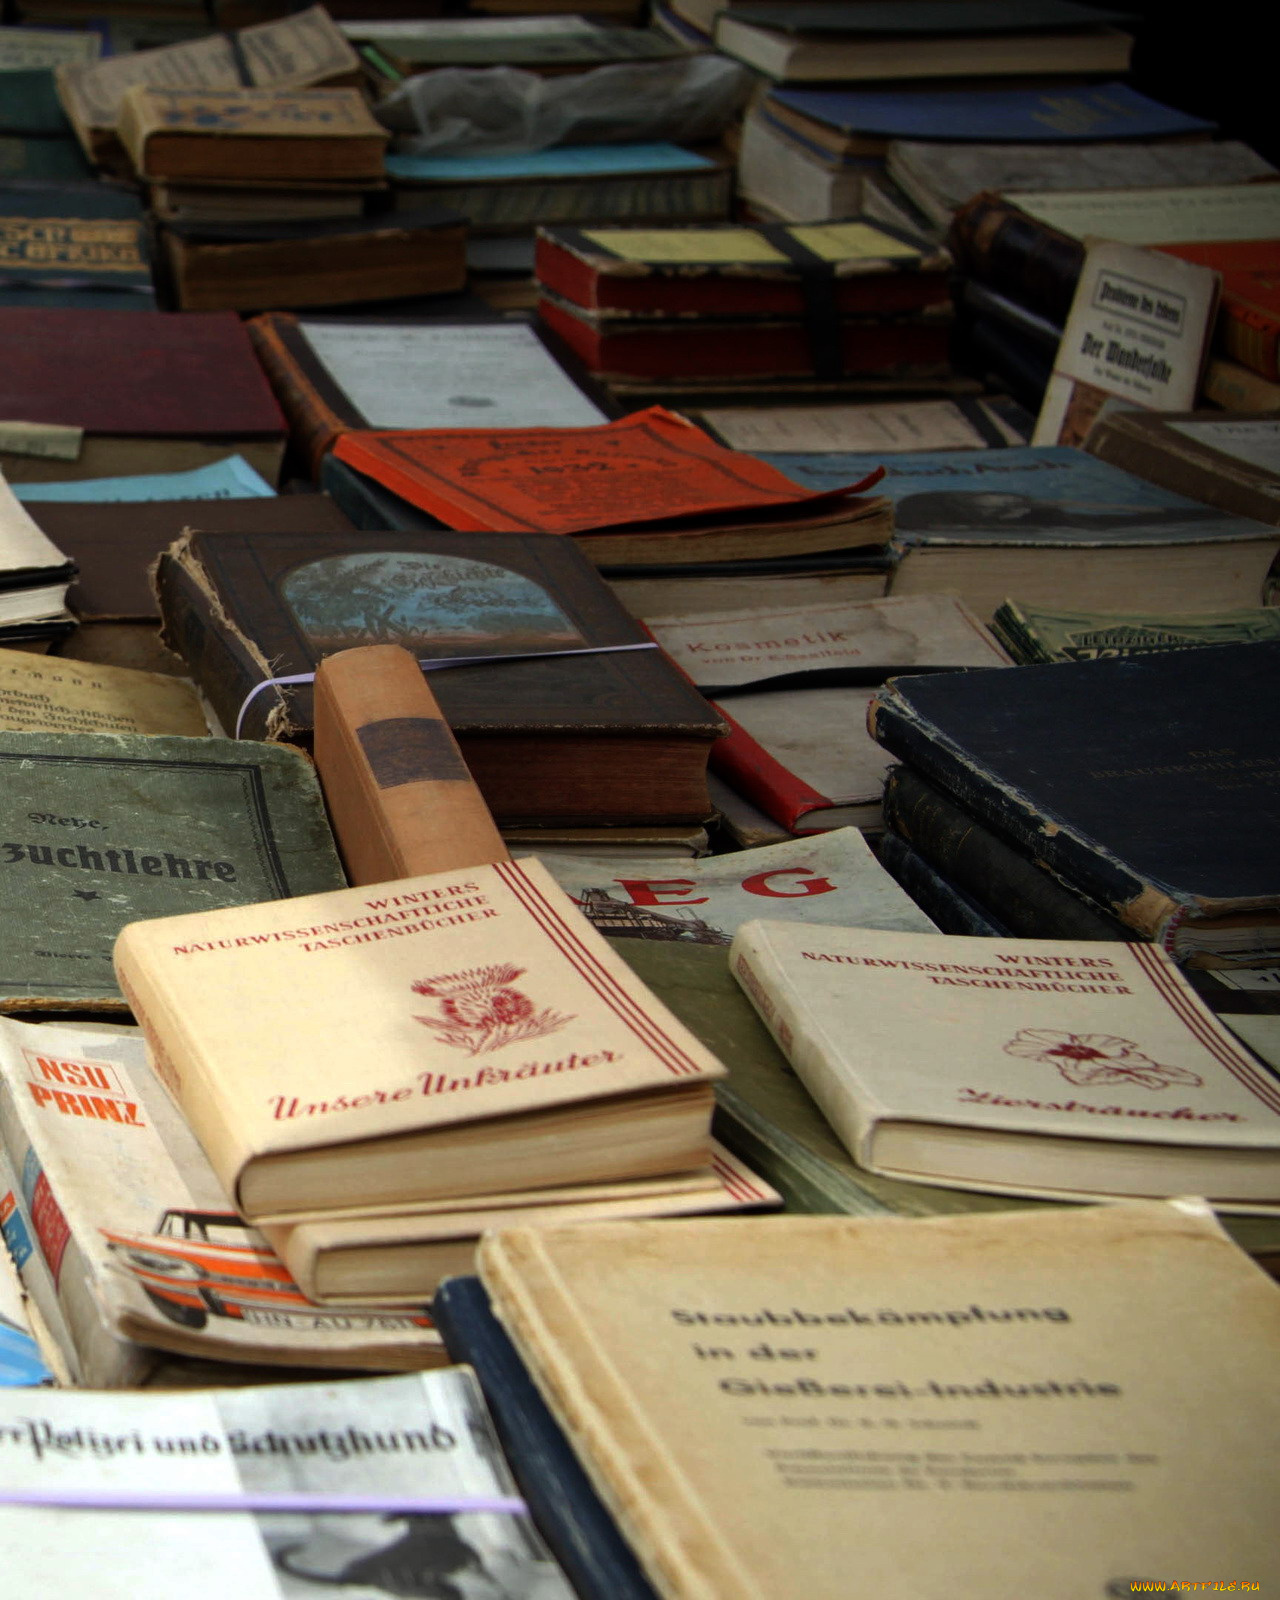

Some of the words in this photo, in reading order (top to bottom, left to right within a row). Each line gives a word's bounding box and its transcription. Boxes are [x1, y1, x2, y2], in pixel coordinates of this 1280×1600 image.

[687, 631, 848, 653] Kosmetik
[364, 881, 482, 911] WINTERS
[172, 893, 489, 956] NATURWISSENSCHAFTLICHE
[299, 905, 501, 953] TASCHENBÜCHER
[801, 950, 1126, 984] NATURWISSENSCHAFTLICHE
[994, 952, 1114, 969] WINTERS
[926, 973, 1136, 996] TASCHENBÜCHER
[35, 1056, 111, 1094] NSU
[268, 1084, 415, 1123] Unsere
[416, 1047, 624, 1099] Unkräuter
[26, 1081, 148, 1129] PRINZ
[669, 1305, 1072, 1330] Staubbekämpfung
[692, 1341, 734, 1362] in
[749, 1340, 819, 1363] der
[719, 1377, 1124, 1400] Gießerei-Industrie
[152, 1424, 222, 1457] und
[227, 1422, 458, 1463] Schutzhund
